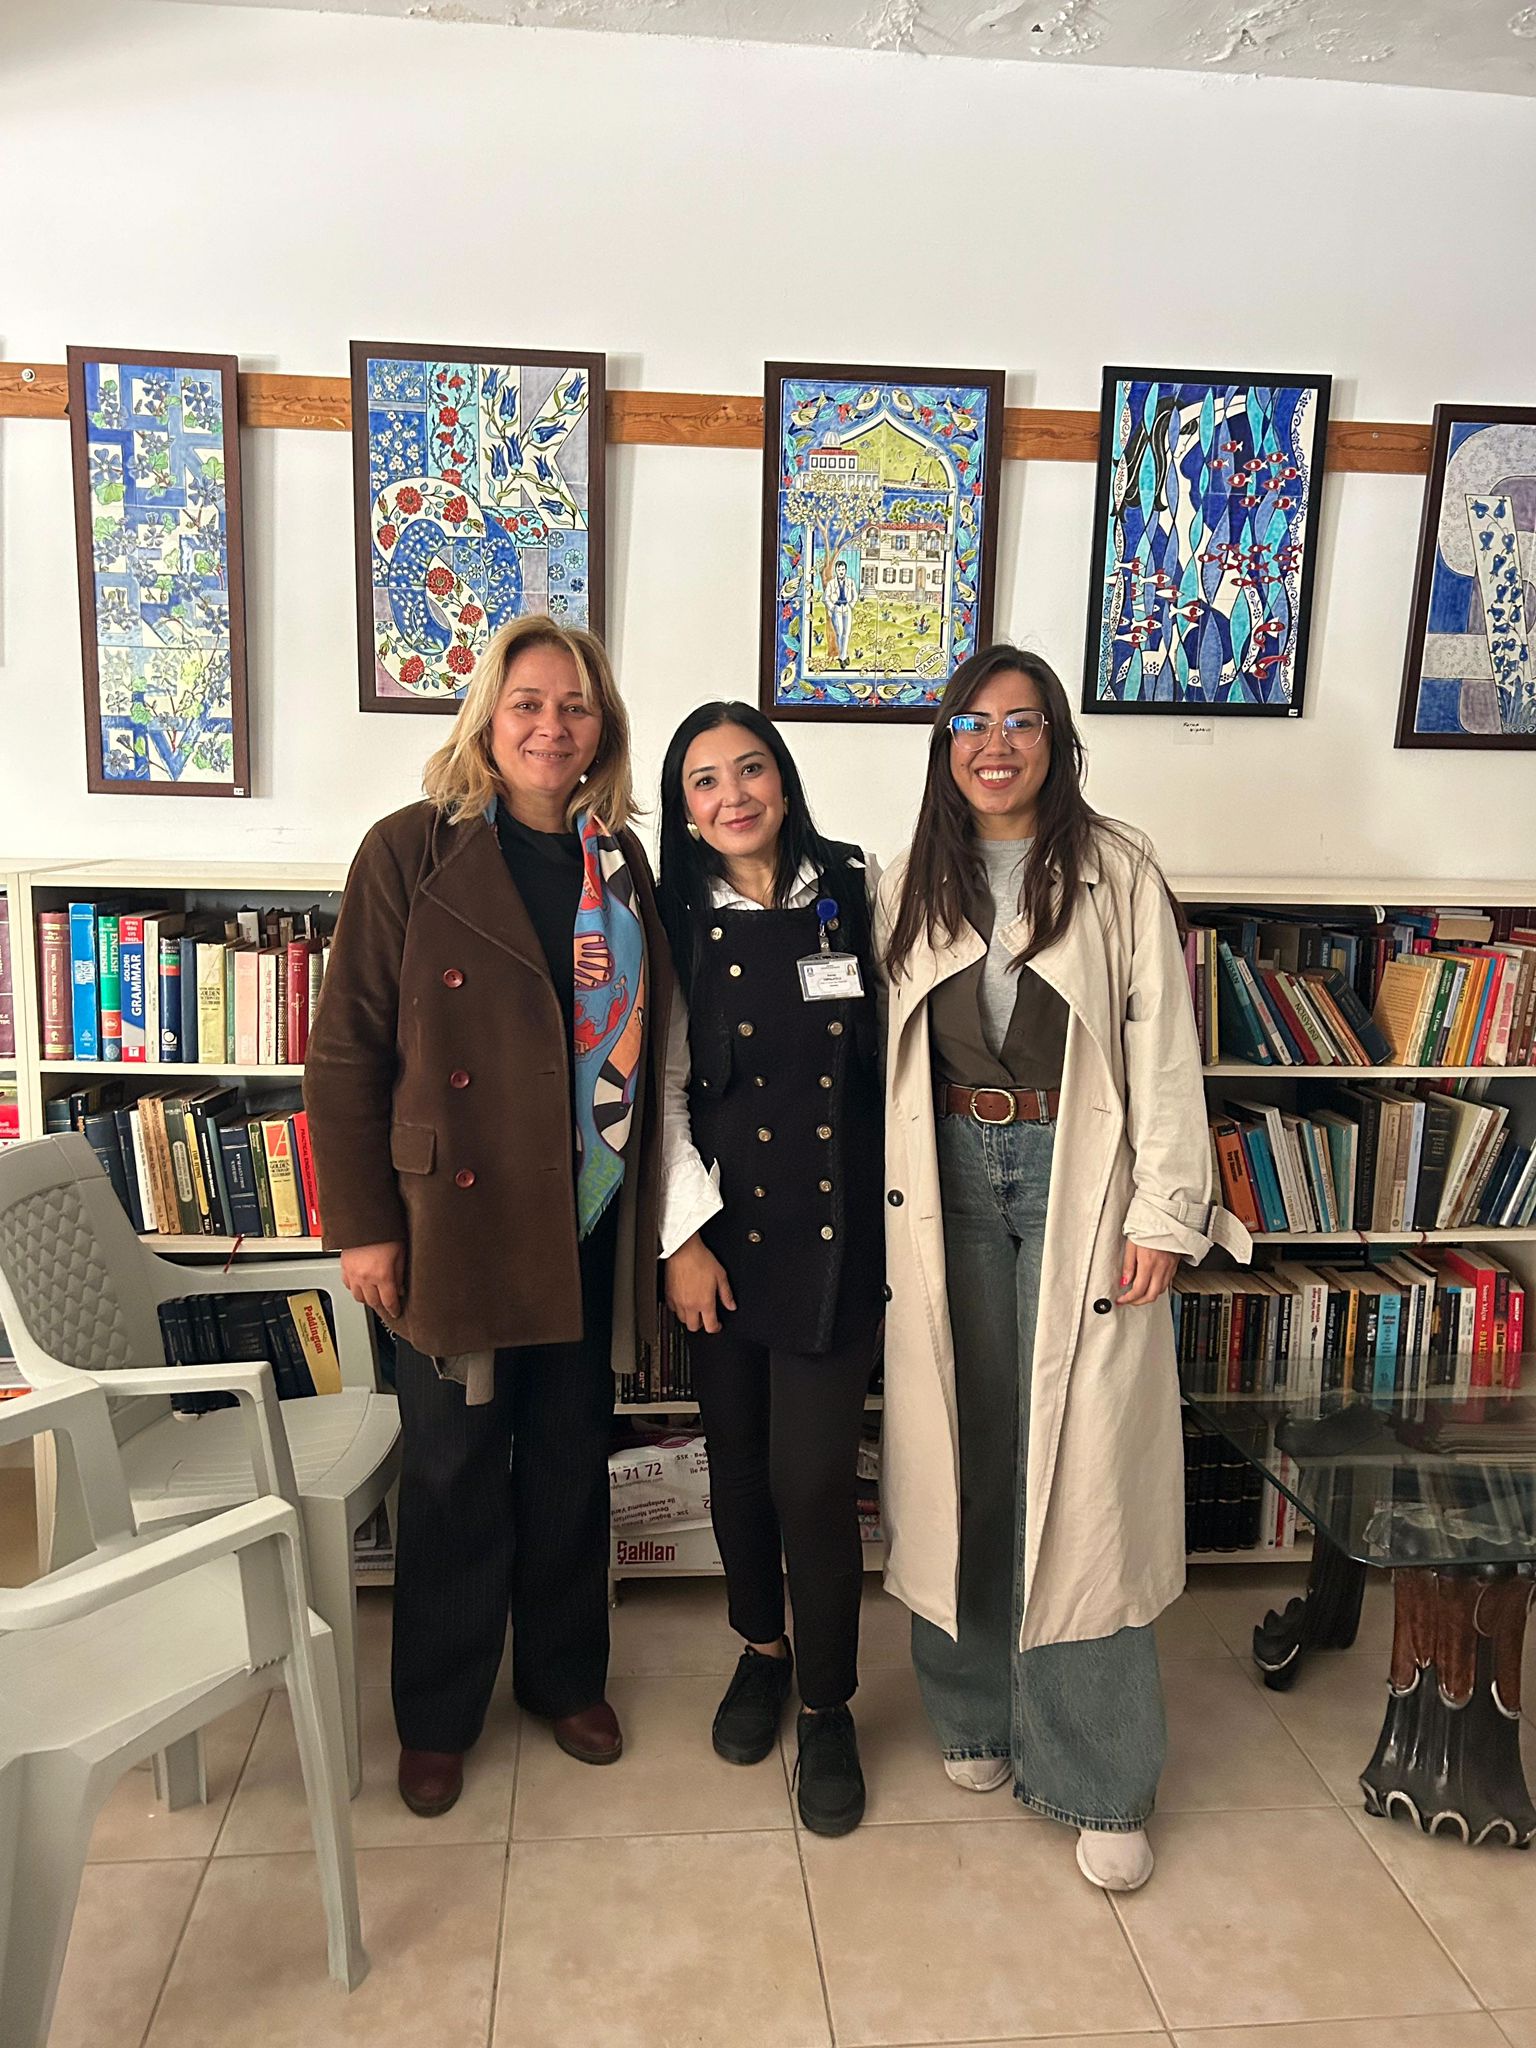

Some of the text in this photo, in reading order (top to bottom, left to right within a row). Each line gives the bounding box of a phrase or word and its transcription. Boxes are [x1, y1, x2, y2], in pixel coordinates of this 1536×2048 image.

[123, 954, 131, 982] GOLDEN
[130, 954, 142, 1017] GRAMMAR
[1294, 1002, 1319, 1041] ENFLASYON
[299, 1128, 308, 1156] PRACTICAL
[304, 1305, 324, 1354] Paddington
[623, 1467, 639, 1480] 71
[644, 1462, 663, 1477] 72
